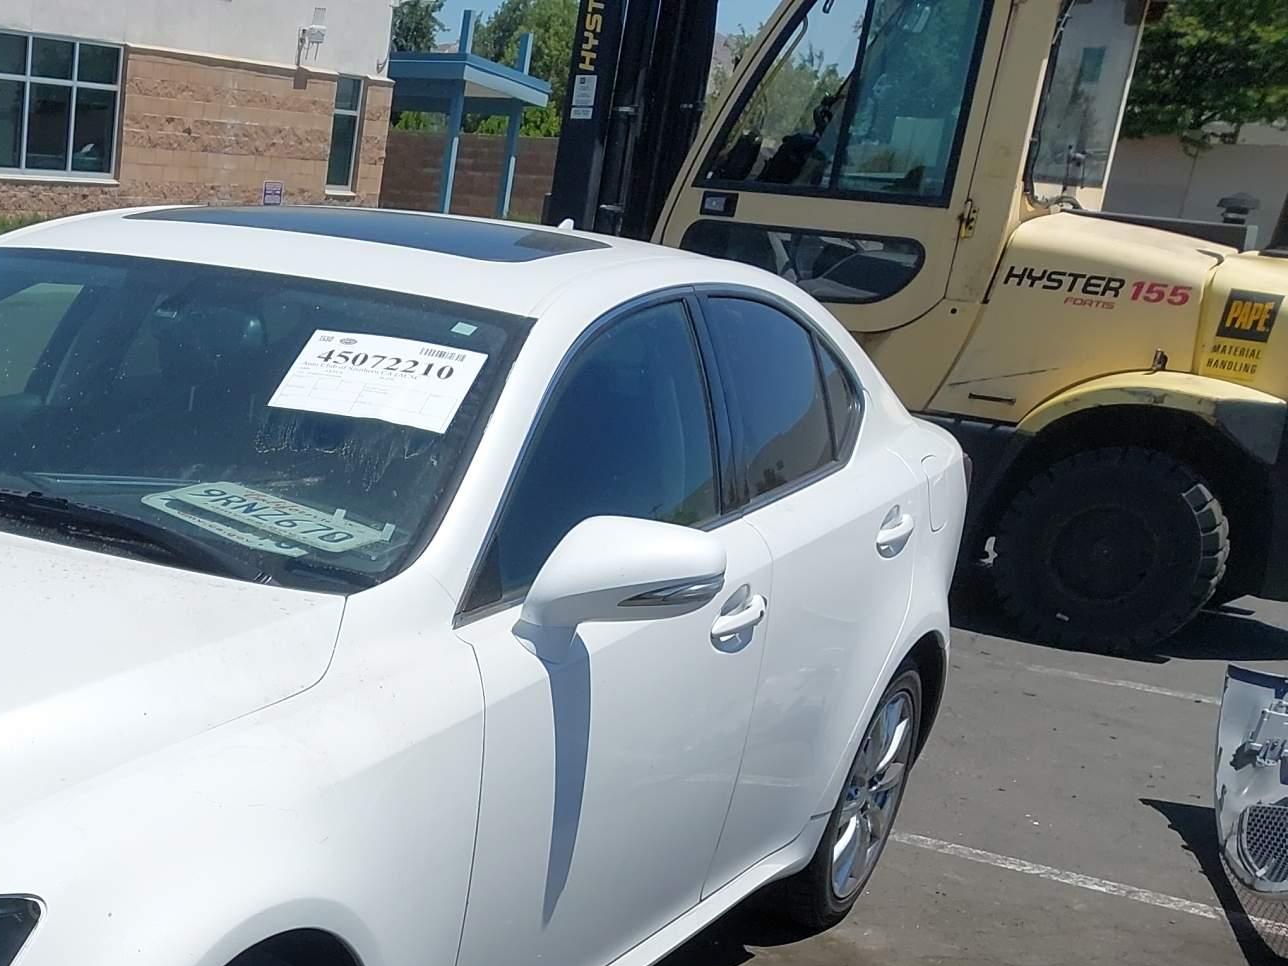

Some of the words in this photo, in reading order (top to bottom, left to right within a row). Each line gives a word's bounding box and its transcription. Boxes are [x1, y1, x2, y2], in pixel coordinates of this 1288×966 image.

[1003, 266, 1126, 298] HYSTER
[1130, 280, 1193, 306] 155
[1064, 296, 1116, 310] FORTIS
[1211, 344, 1262, 360] MATERIAL
[316, 349, 454, 380] 45072210
[1206, 358, 1258, 374] HANDLING
[188, 488, 354, 543] 9RNZ670
